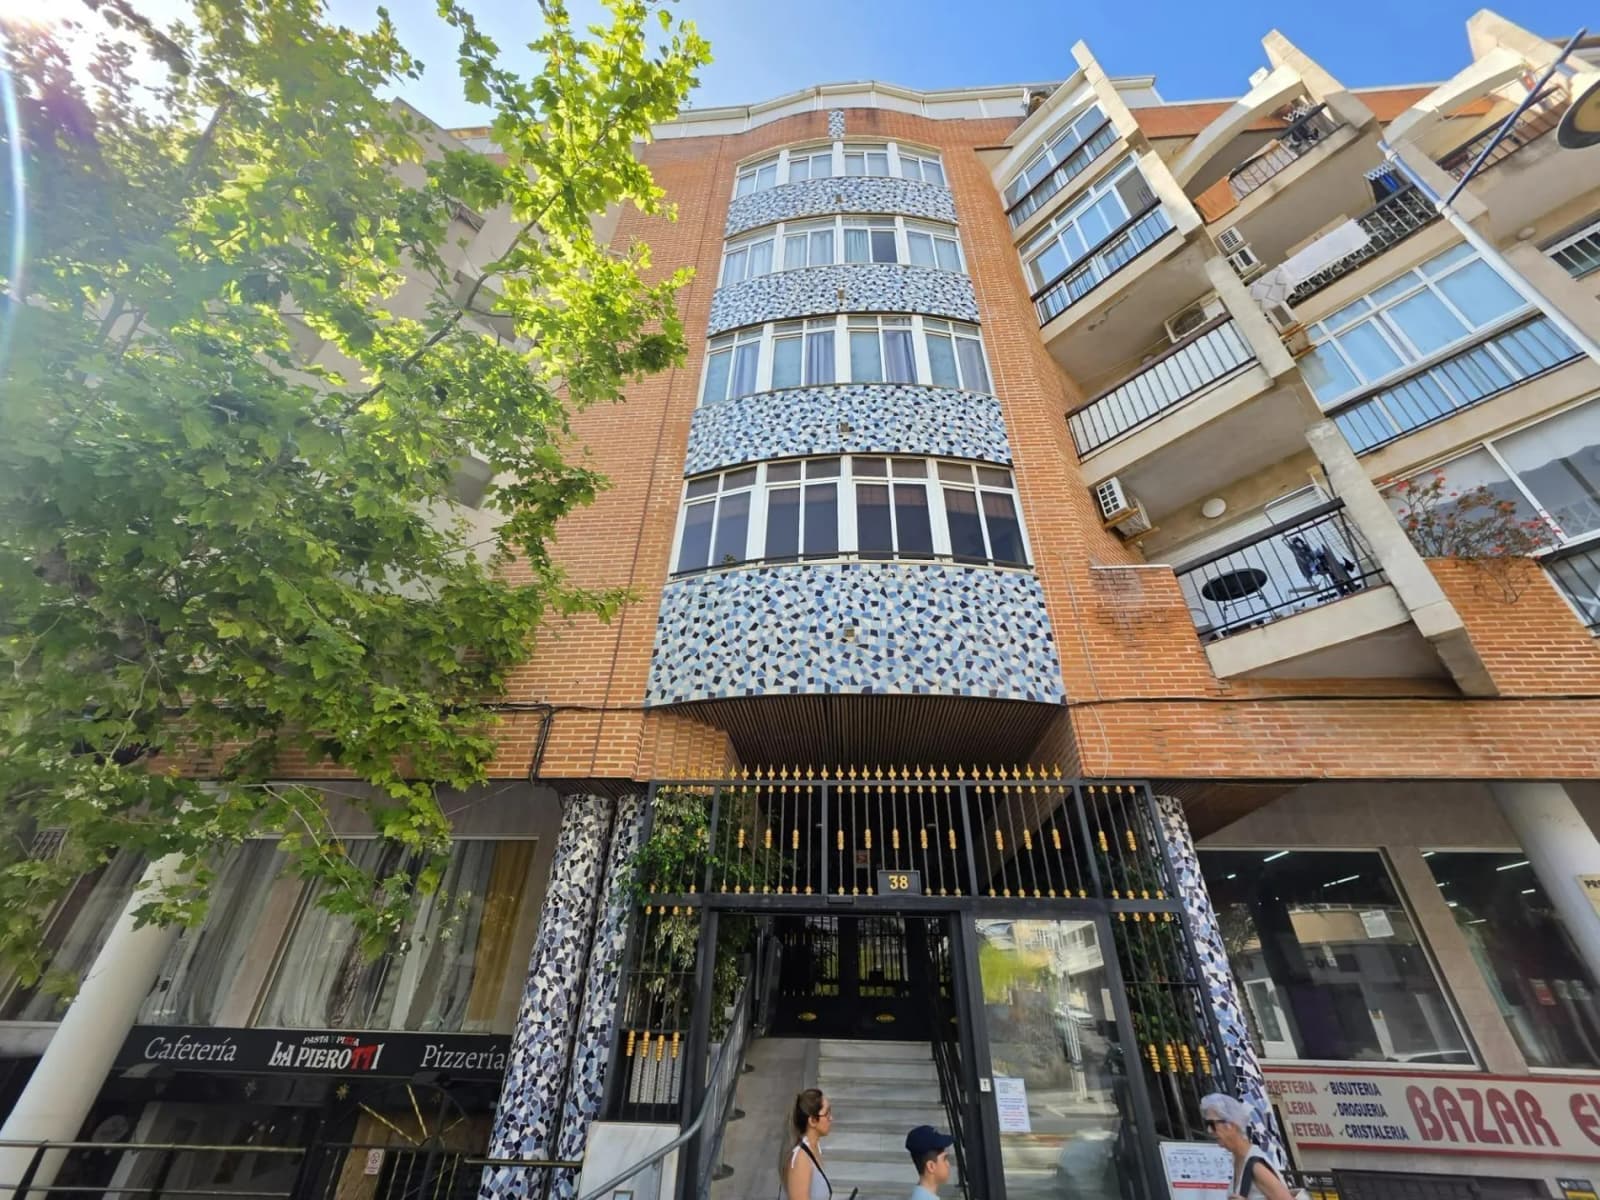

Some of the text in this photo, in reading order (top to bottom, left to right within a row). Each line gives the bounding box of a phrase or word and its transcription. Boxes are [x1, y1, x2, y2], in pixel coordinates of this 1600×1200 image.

[888, 875, 909, 890] 38
[144, 1035, 238, 1062] Cafetería
[303, 1035, 329, 1044] PASTA
[336, 1036, 360, 1047] PIZZA
[268, 1040, 385, 1071] LA PIEROTTI
[420, 1043, 506, 1069] Pizzería
[1329, 1081, 1382, 1096] BISUTERIA
[1336, 1102, 1389, 1118] DROGUERIA
[1405, 1085, 1561, 1148] BAZAR
[1345, 1123, 1410, 1140] CRISTALERIA
